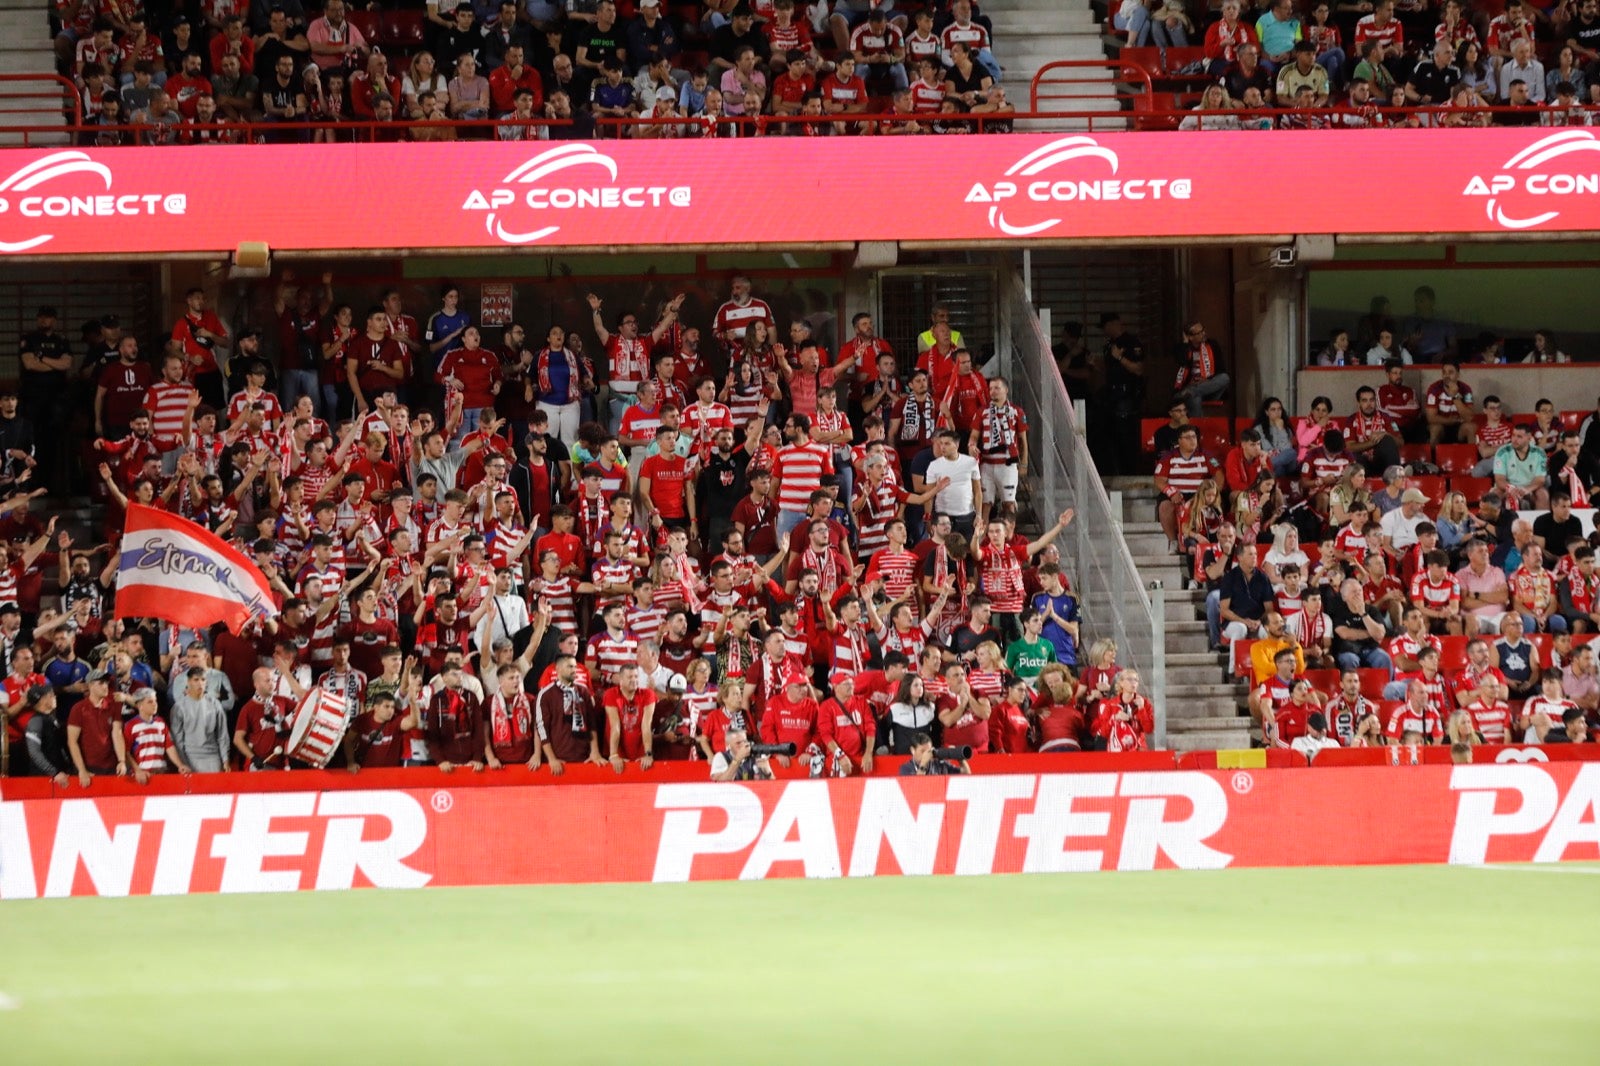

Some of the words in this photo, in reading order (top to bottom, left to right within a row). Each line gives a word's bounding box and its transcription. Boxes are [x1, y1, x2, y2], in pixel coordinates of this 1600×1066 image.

[964, 182, 1017, 202] AP
[1028, 179, 1191, 201] CONECT@
[1462, 175, 1516, 195] AP
[19, 193, 187, 217] CONECT@
[462, 189, 515, 209] AP
[526, 187, 691, 208] CONECT@
[137, 537, 220, 583] Eterna
[651, 772, 1234, 884] PANTER
